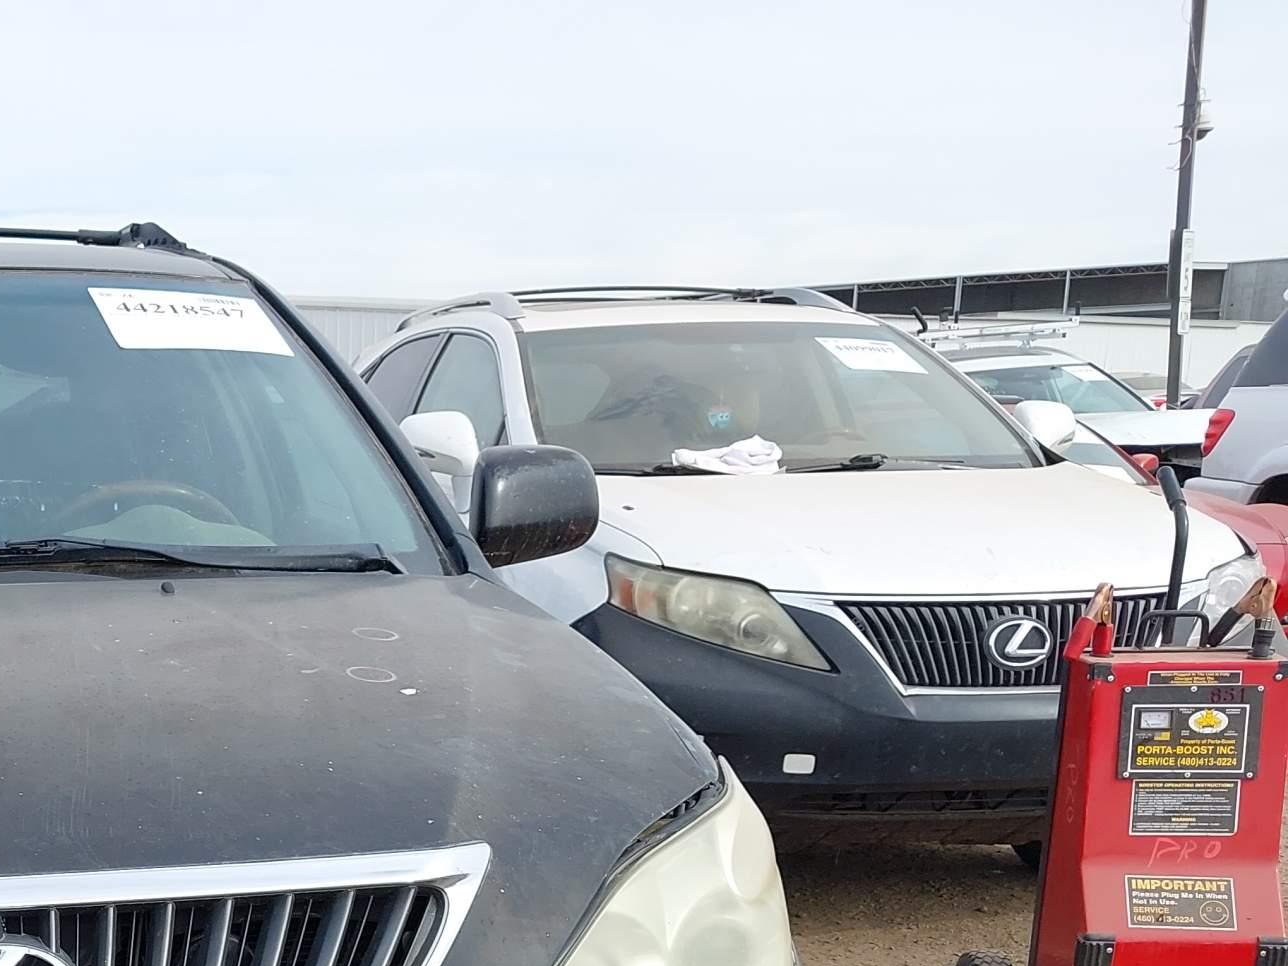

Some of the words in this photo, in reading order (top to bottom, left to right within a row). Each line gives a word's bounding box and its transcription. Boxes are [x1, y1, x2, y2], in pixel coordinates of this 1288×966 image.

[116, 302, 244, 318] 44218547
[1137, 745, 1213, 754] PORTA-BOOST
[1216, 745, 1237, 754] INC.
[1136, 757, 1175, 766] SERVICE
[1177, 757, 1237, 767] (480)413-0224
[1132, 879, 1227, 891] IMPORTANT
